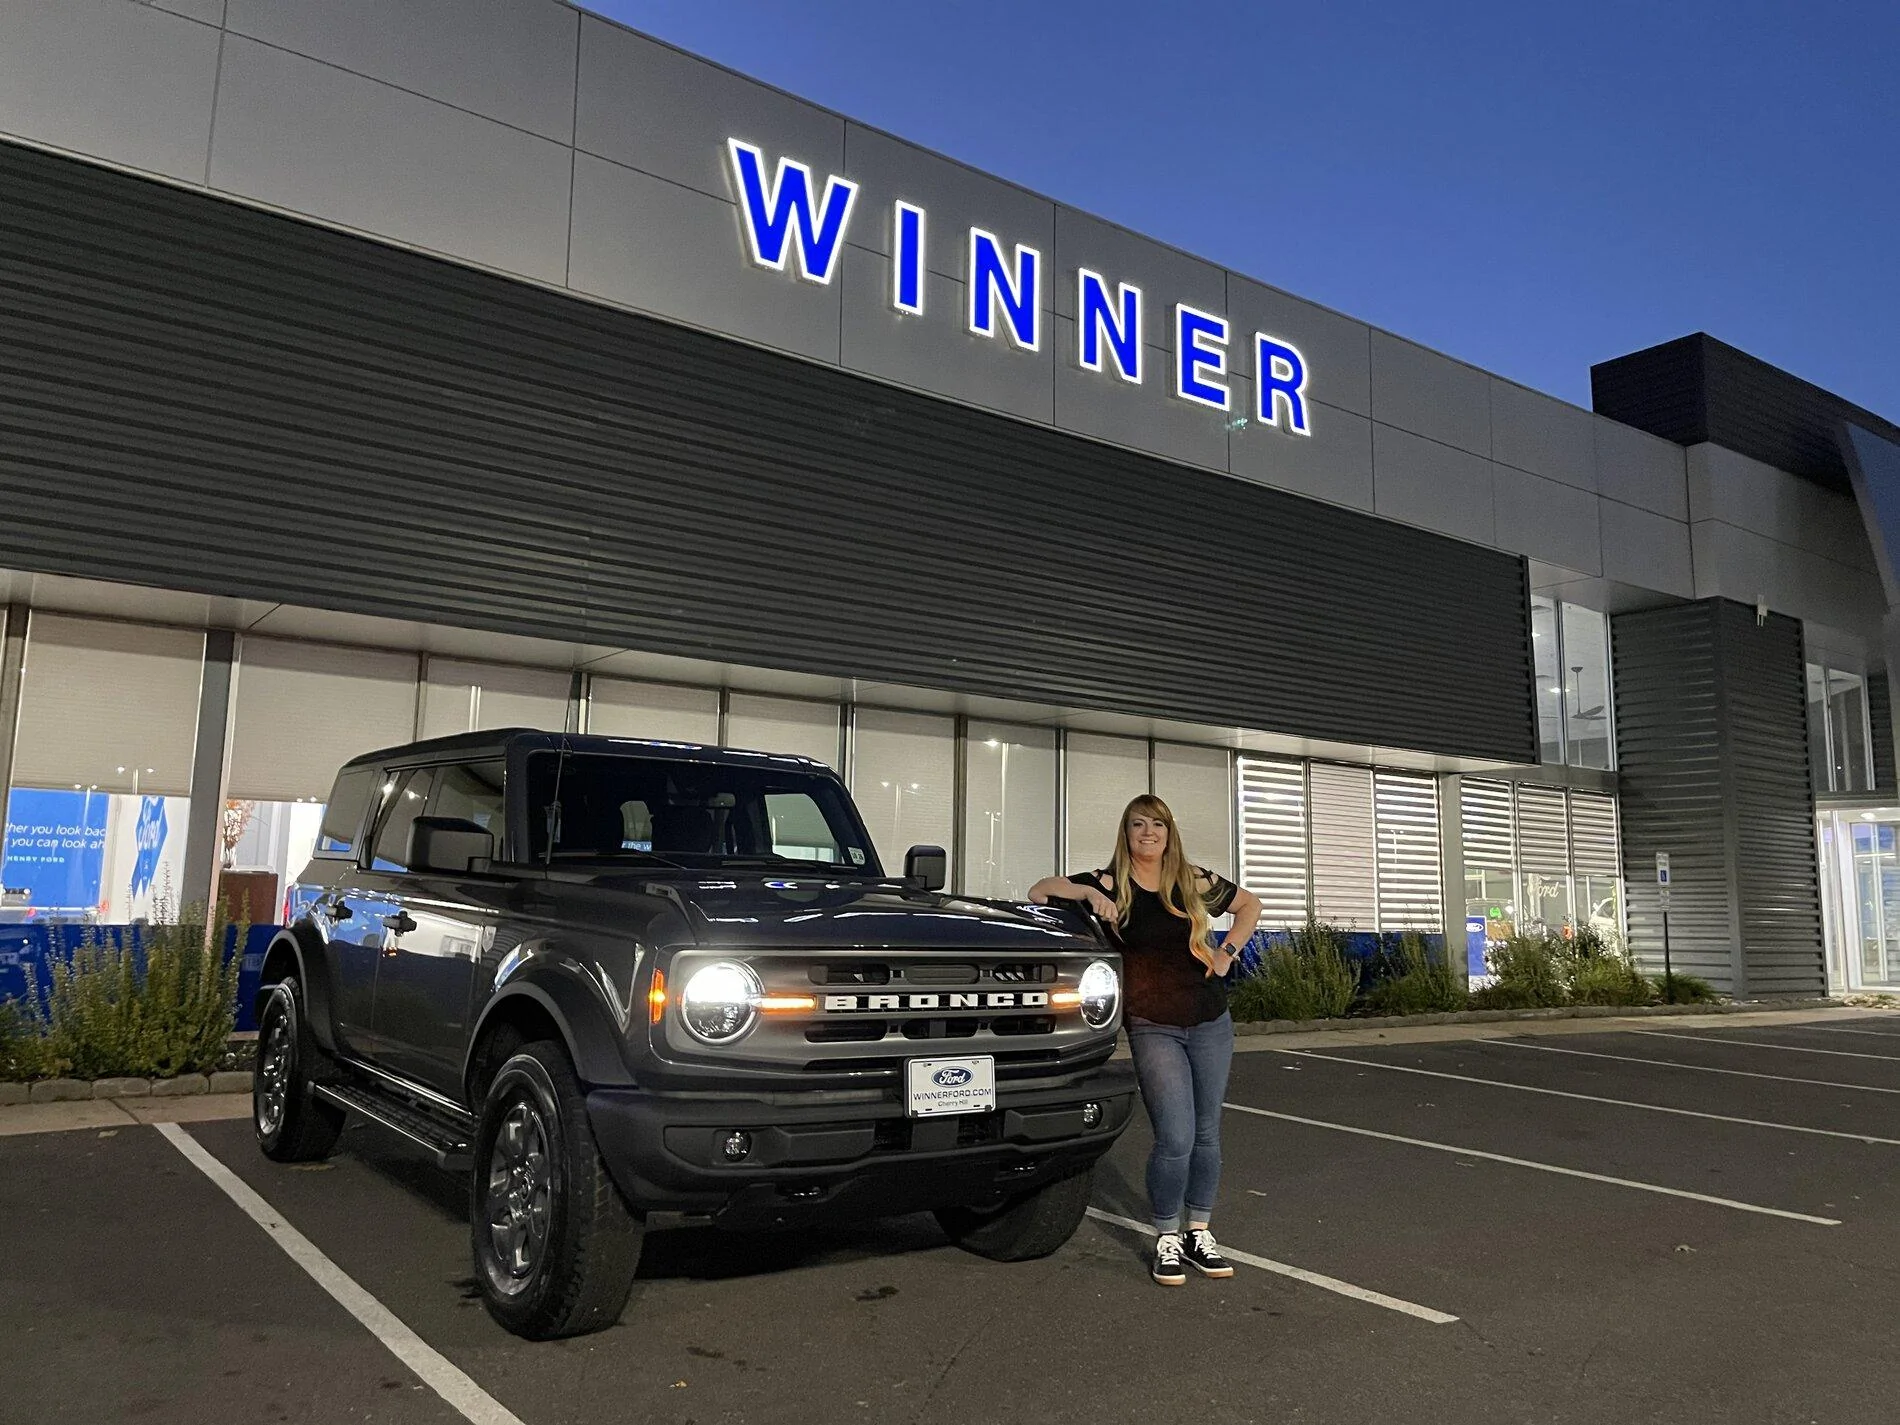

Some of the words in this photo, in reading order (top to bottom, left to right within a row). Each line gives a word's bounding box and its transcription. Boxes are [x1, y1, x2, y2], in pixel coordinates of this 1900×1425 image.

[727, 137, 1312, 437] WINNER
[30, 826, 53, 835] you
[56, 824, 81, 835] look
[11, 838, 34, 848] you
[36, 839, 58, 848] can
[62, 838, 86, 848] look
[7, 855, 37, 863] HENRY
[825, 993, 1048, 1010] BRONCO
[939, 1069, 966, 1084] Ford
[913, 1088, 992, 1100] WINNERFORD.COM
